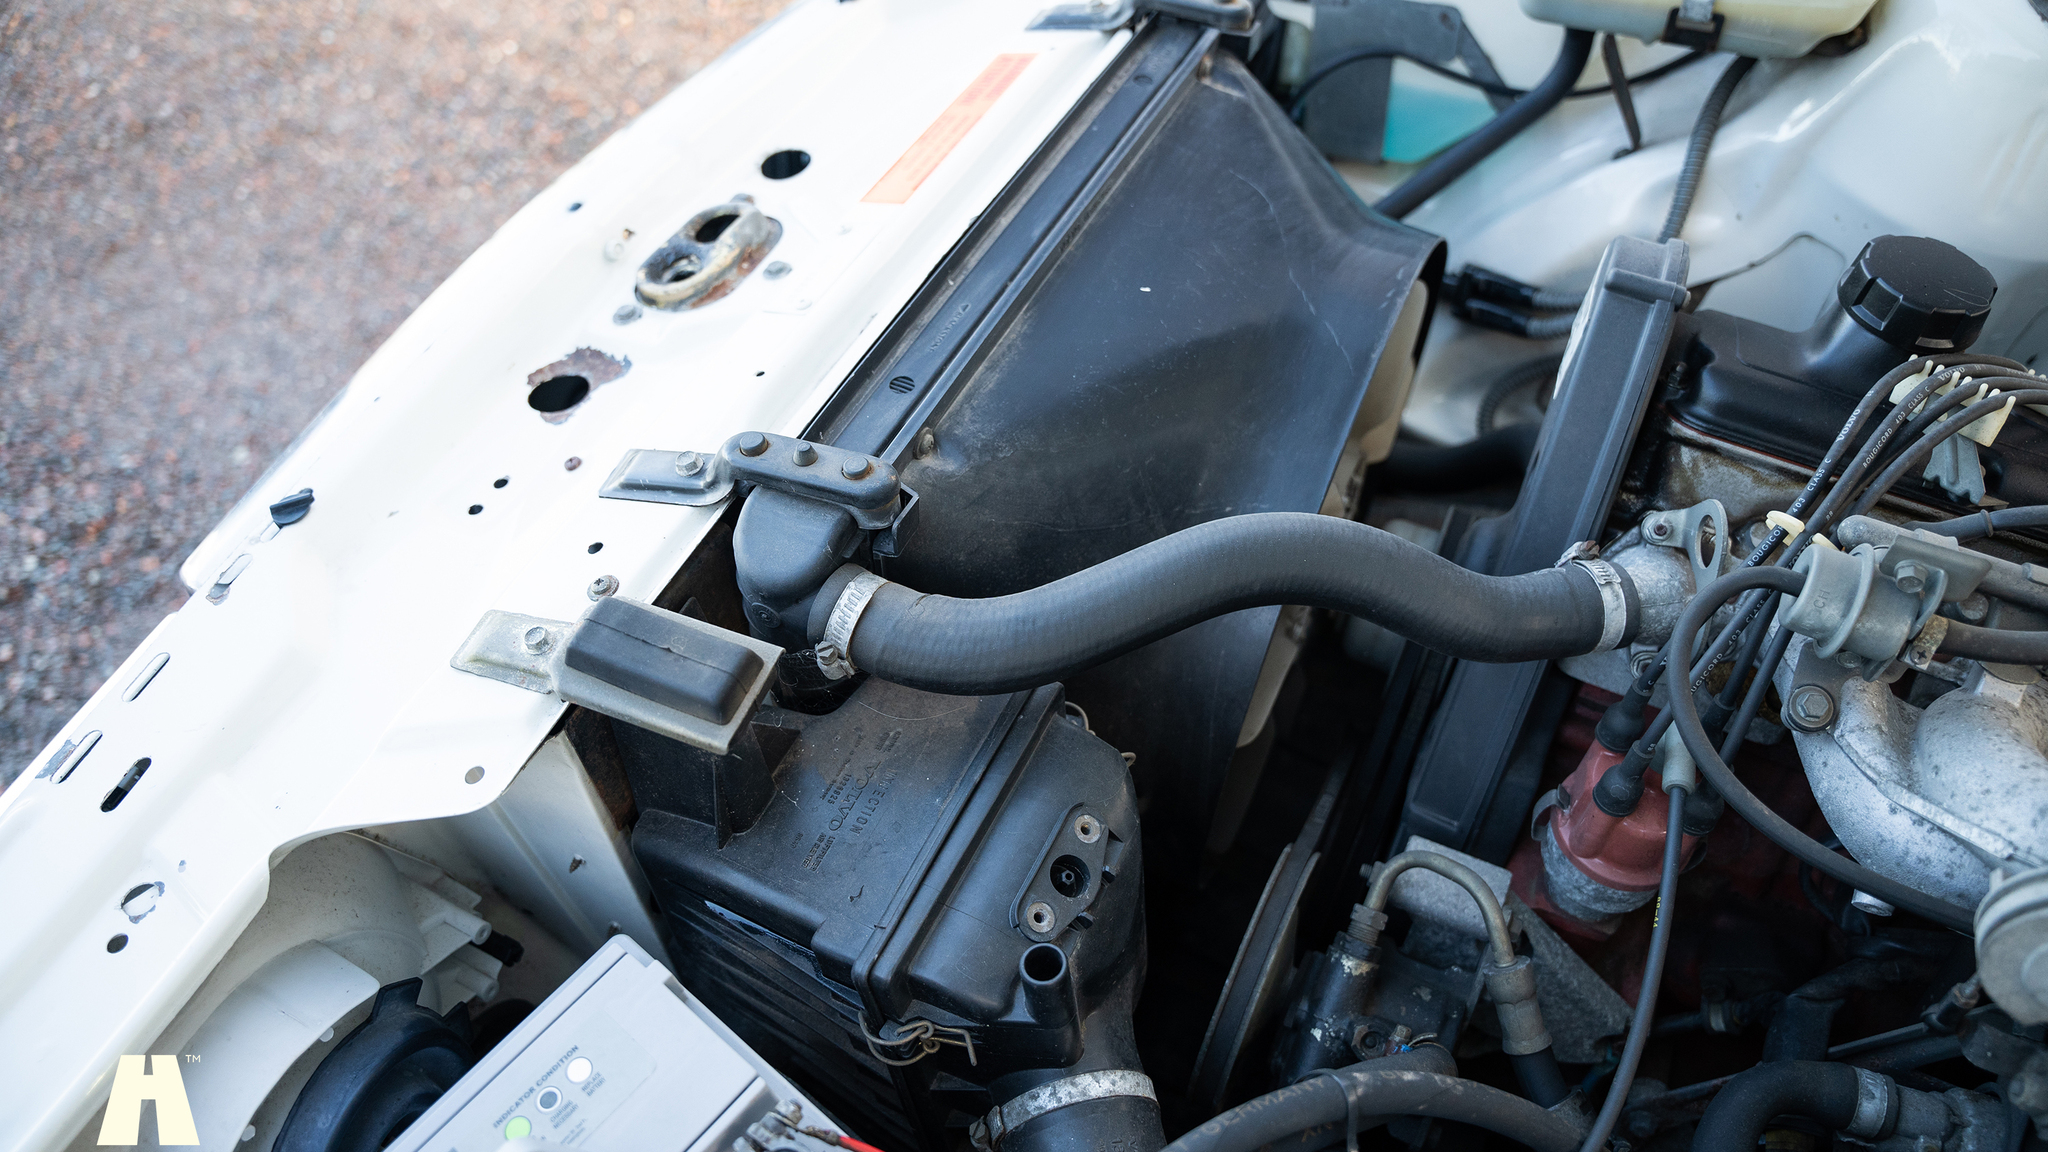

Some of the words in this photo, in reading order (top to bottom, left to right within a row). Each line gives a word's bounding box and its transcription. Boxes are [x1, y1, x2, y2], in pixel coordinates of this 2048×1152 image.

[1862, 427, 1893, 469] BOUGICORD
[1895, 411, 1906, 424] 403
[1907, 393, 1924, 409] CLASS
[1792, 497, 1806, 513] 403
[1807, 467, 1826, 491] CLASS
[1835, 408, 1861, 442] VOLVO
[1813, 588, 1831, 609] CH
[1728, 629, 1742, 646] 403
[1745, 600, 1765, 623] CLASS
[828, 761, 882, 831] VOLVO
[493, 1086, 536, 1129] INDICATOR
[536, 1044, 579, 1087] CONDITION
[581, 1071, 602, 1092] REPLACE
[587, 1076, 606, 1097] BATTERY
[549, 1099, 574, 1123] CHARGING
[553, 1103, 579, 1130] NECESSARY
